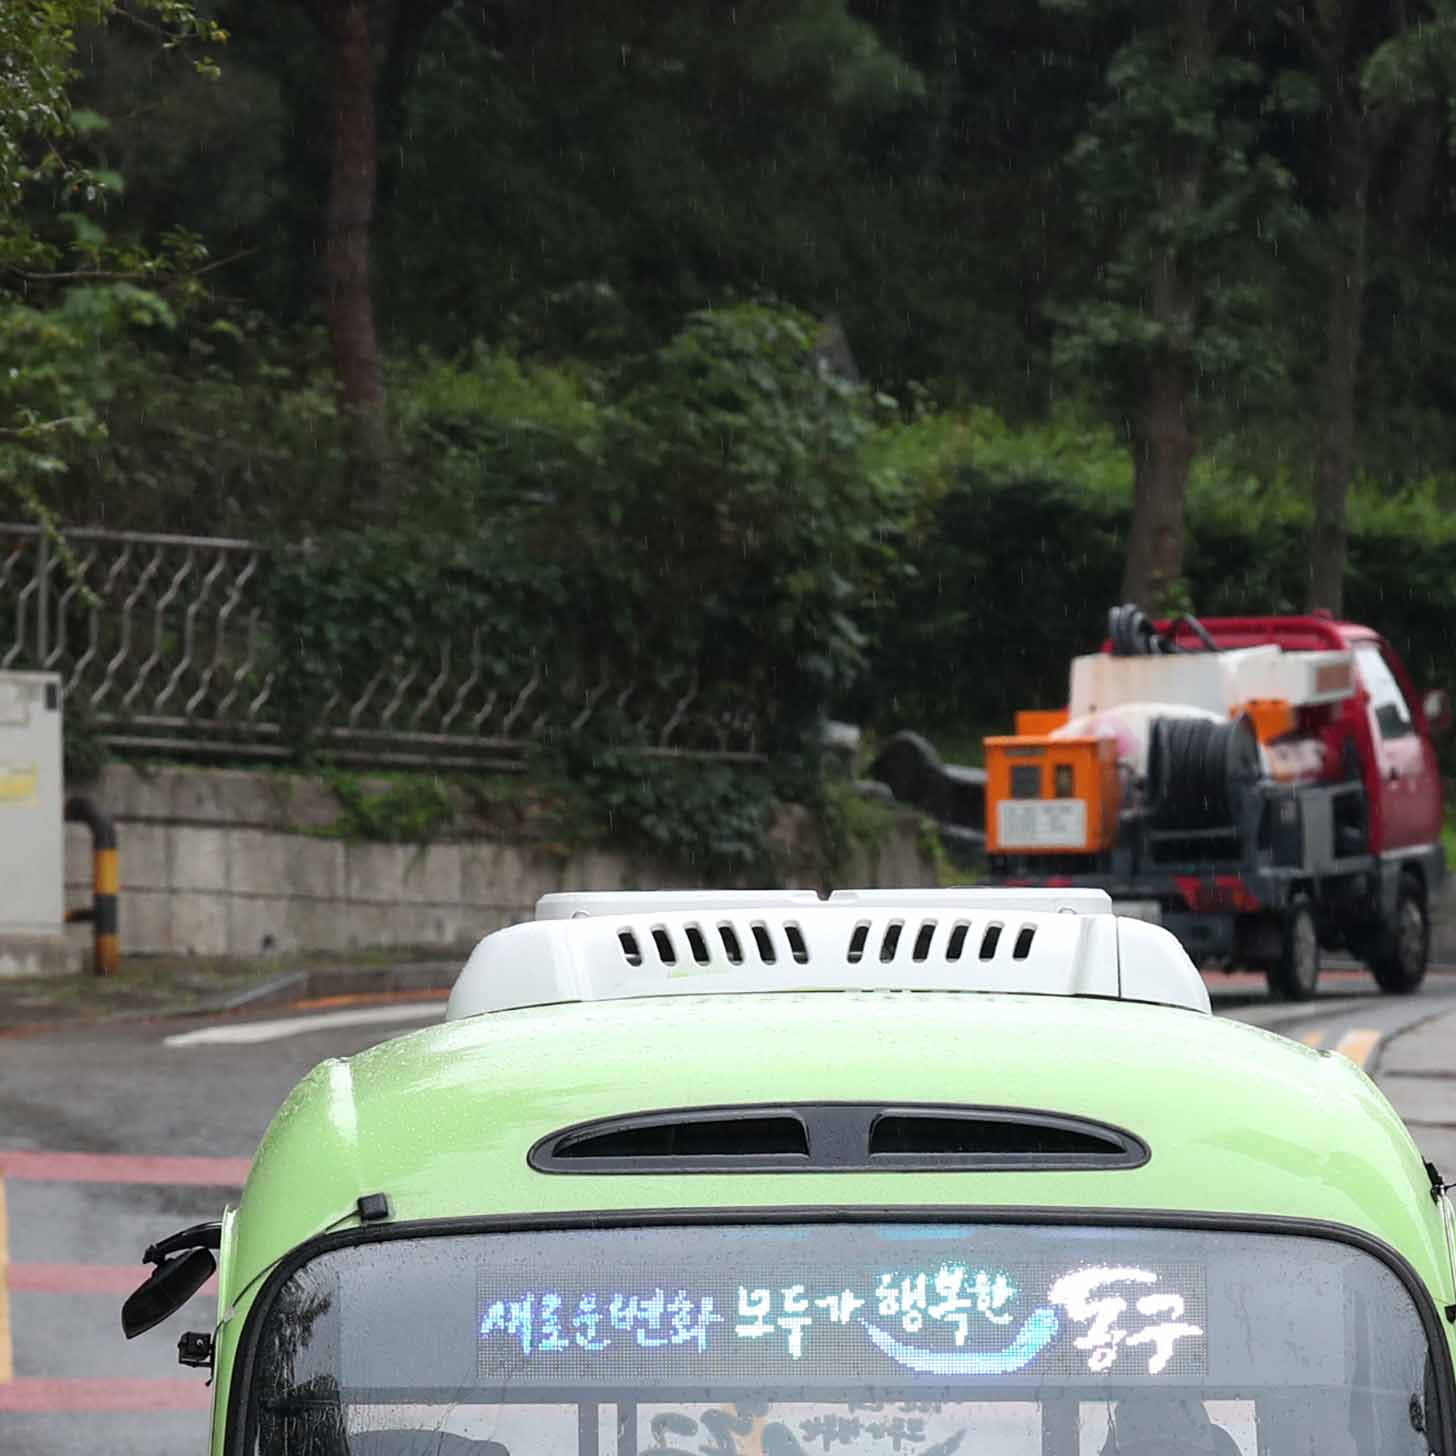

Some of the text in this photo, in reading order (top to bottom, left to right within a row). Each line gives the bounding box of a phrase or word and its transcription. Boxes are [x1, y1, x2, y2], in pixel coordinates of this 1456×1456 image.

[734, 1285, 864, 1359] 모두가
[873, 1264, 1016, 1346] 행복한
[1047, 1266, 1204, 1374] 동구
